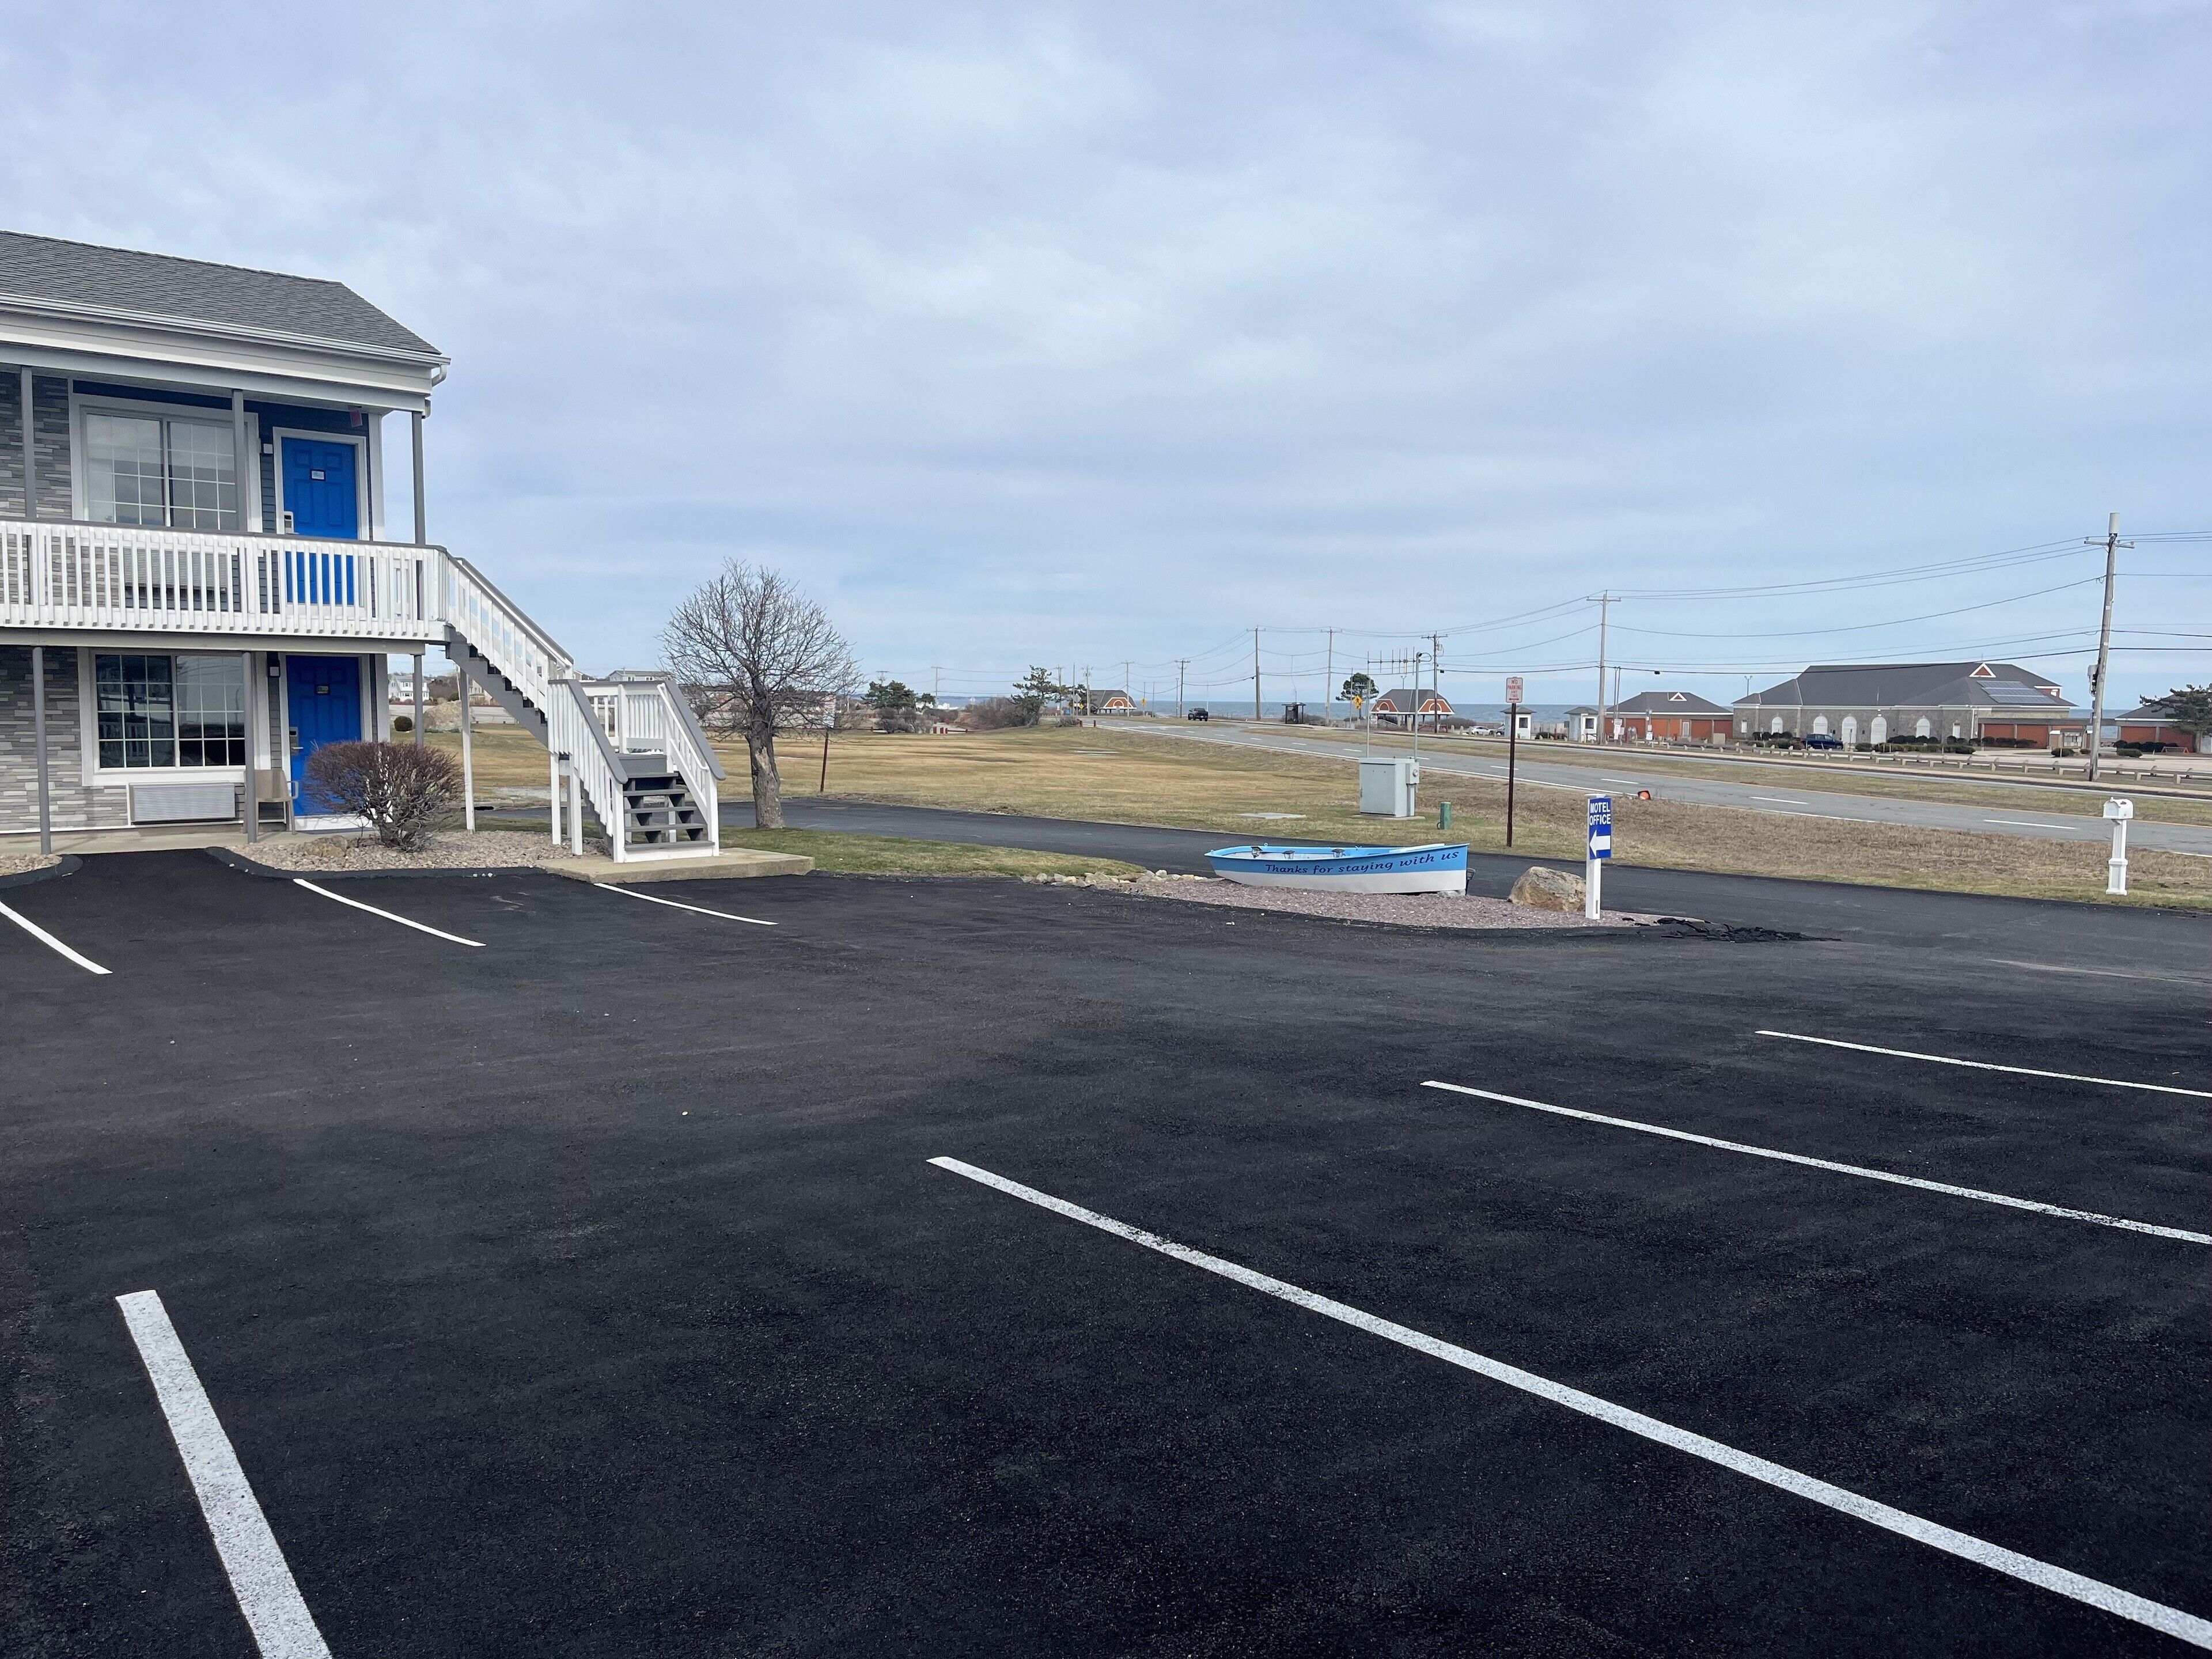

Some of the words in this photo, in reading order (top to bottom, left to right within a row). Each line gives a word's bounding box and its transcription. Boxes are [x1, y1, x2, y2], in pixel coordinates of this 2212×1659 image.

[1590, 802, 1611, 813] MOTEL
[1589, 813, 1611, 826] OFFICE
[1265, 864, 1308, 873] Thanks
[1313, 865, 1334, 874] for
[1338, 862, 1393, 873] staying
[1400, 853, 1435, 867] with
[1441, 851, 1459, 861] us
